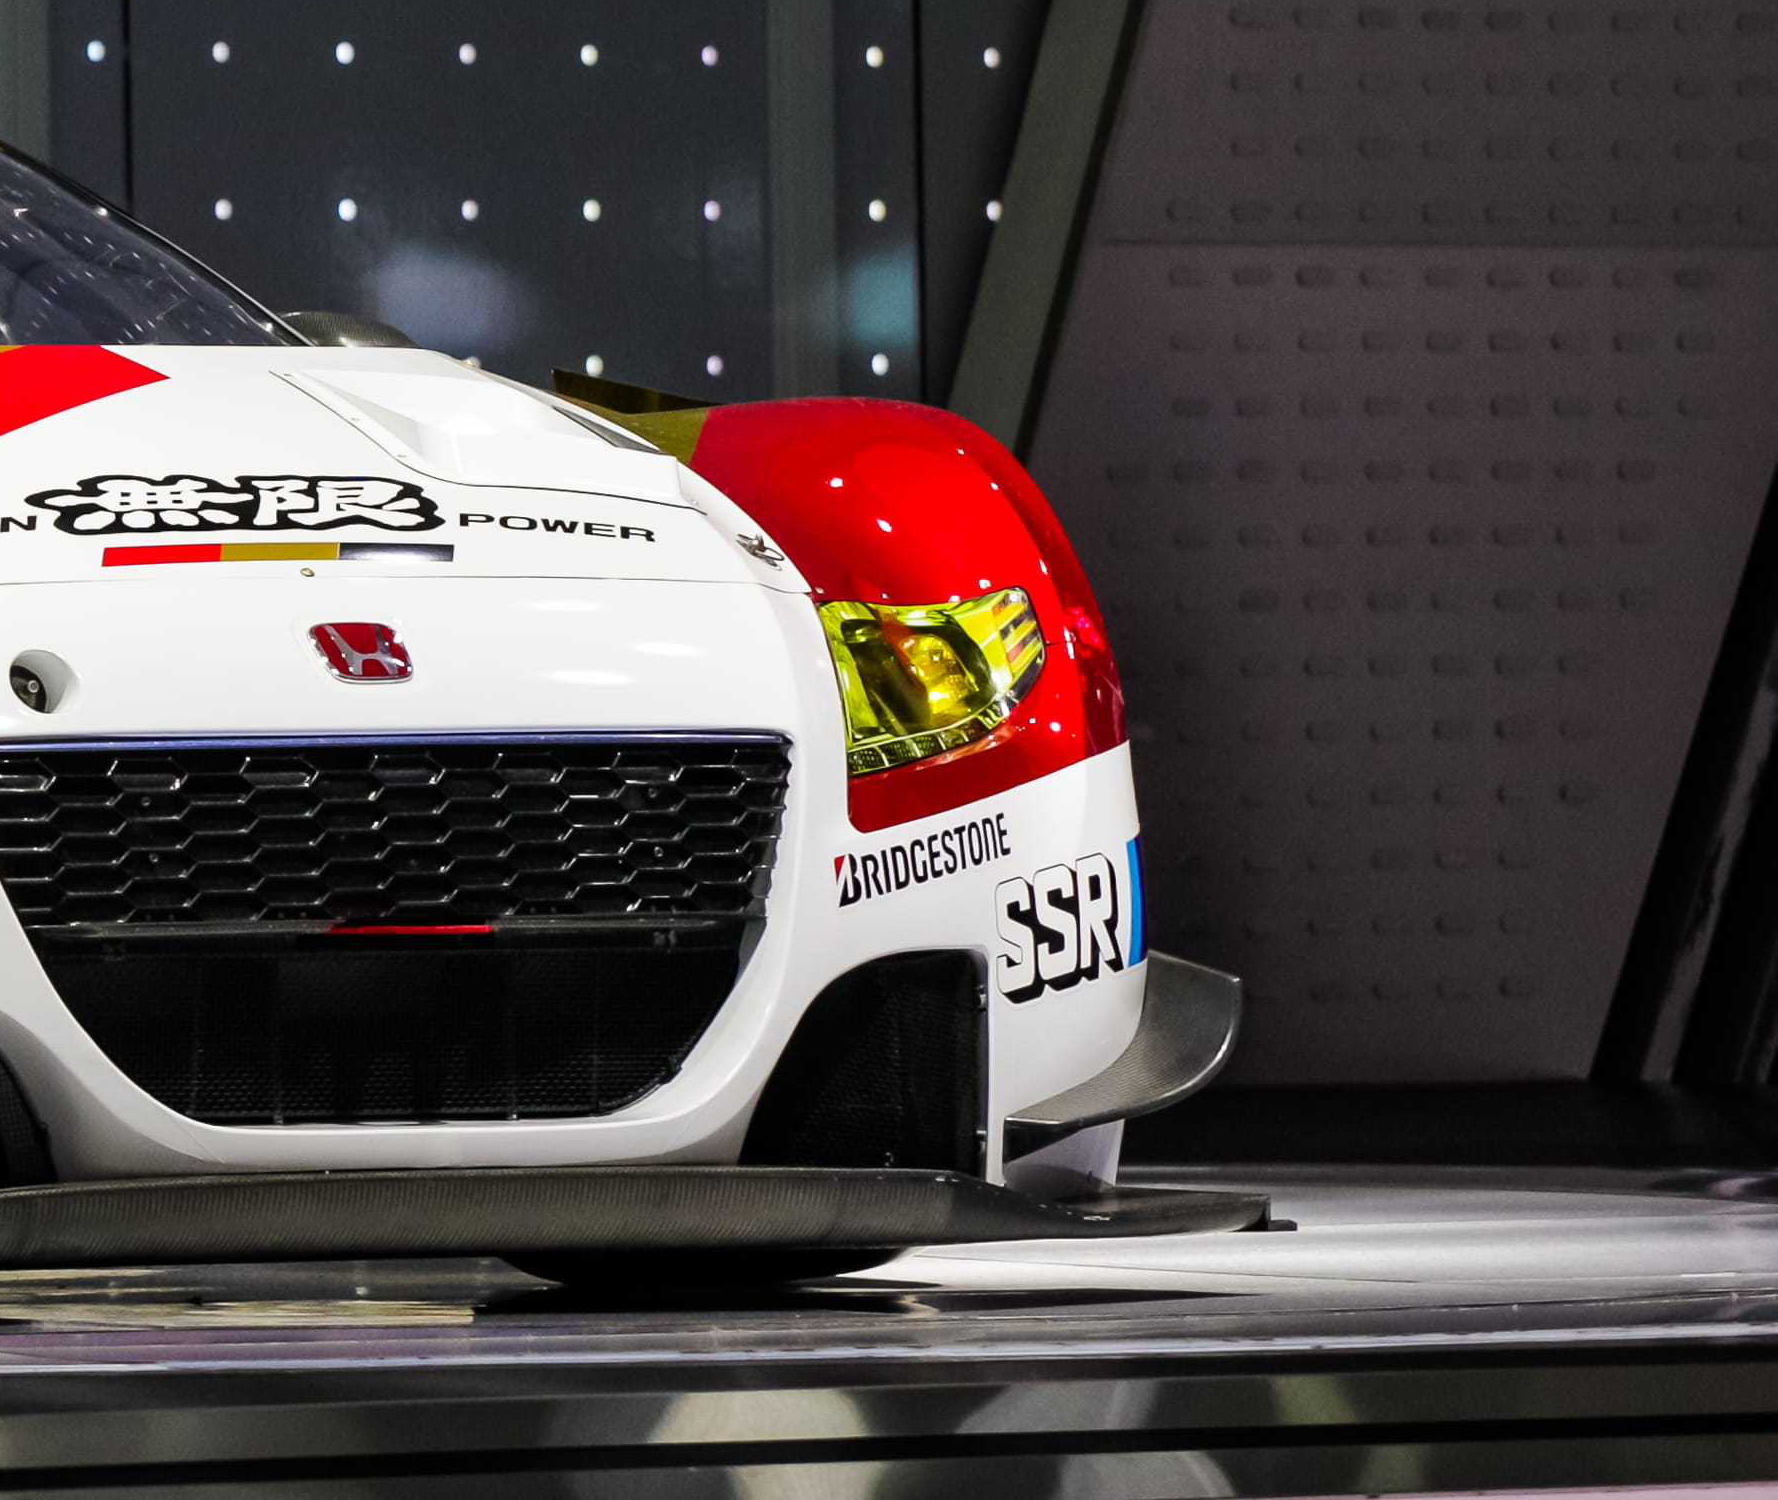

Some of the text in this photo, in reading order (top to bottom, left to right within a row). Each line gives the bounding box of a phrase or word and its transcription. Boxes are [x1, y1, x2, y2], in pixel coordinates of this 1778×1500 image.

[24, 474, 445, 534] 無限
[458, 512, 657, 543] POWER
[833, 811, 1012, 908] BRIDGESTONE
[996, 851, 1124, 1005] SSR
